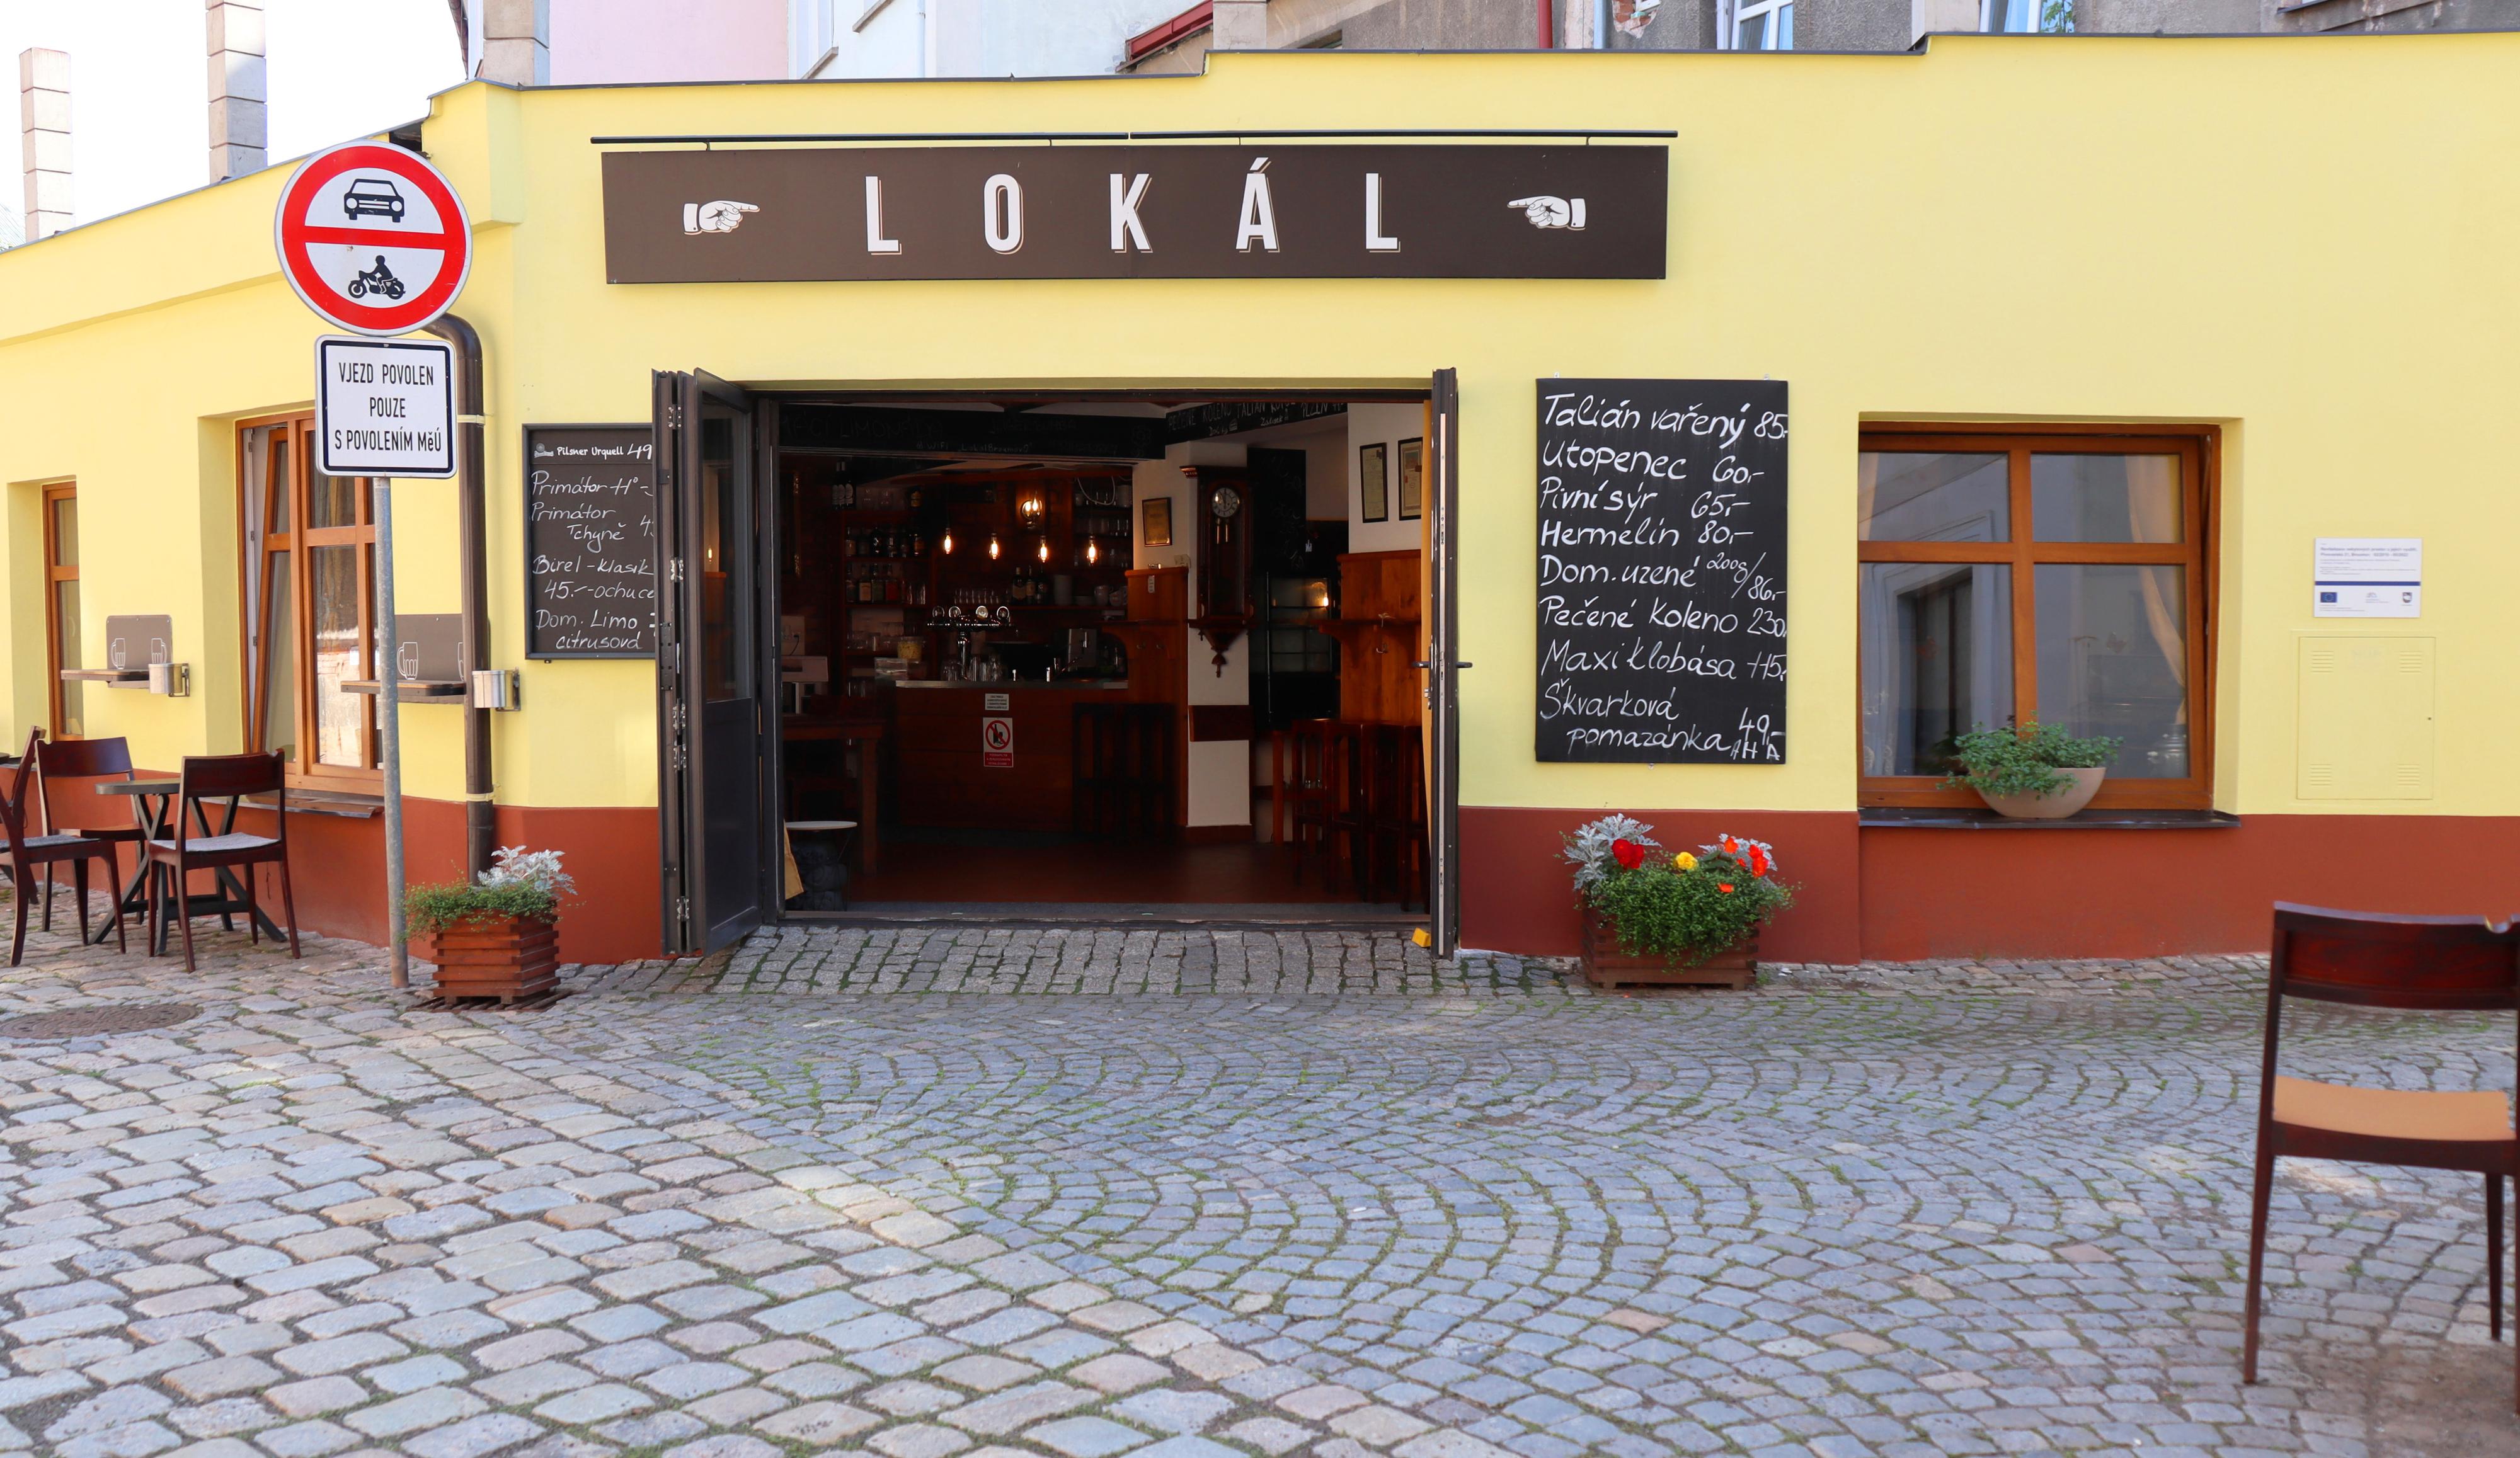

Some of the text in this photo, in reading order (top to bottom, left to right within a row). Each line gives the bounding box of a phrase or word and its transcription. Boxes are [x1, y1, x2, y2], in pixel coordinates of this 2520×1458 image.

[865, 157, 1401, 256] LOKÁL
[339, 362, 434, 385] VJEZD POVOLEN
[370, 397, 406, 418] POUZE
[1545, 392, 1641, 429] Talián
[1651, 402, 1751, 450] vařený
[335, 426, 442, 452] S POVOLENÍM MěÚ
[556, 446, 588, 456] Pilsner
[591, 446, 624, 460] Urquell
[1543, 439, 1687, 480] Utopenec
[531, 470, 608, 496] Primátor
[531, 501, 616, 522] Primátor
[1540, 476, 1608, 510] Pivní
[1603, 481, 1658, 525] sýr
[566, 522, 626, 554] Tchyně
[1541, 516, 1680, 547] Hermelín
[532, 554, 581, 574] Birel
[1621, 555, 1700, 588] uzené
[590, 609, 638, 629] Limo
[1539, 595, 1638, 629] Pečené
[1541, 639, 1625, 676] Maxi
[1626, 636, 1737, 680] klobása
[1540, 678, 1680, 720] Škvarková
[1566, 724, 1732, 755] pomazánka
